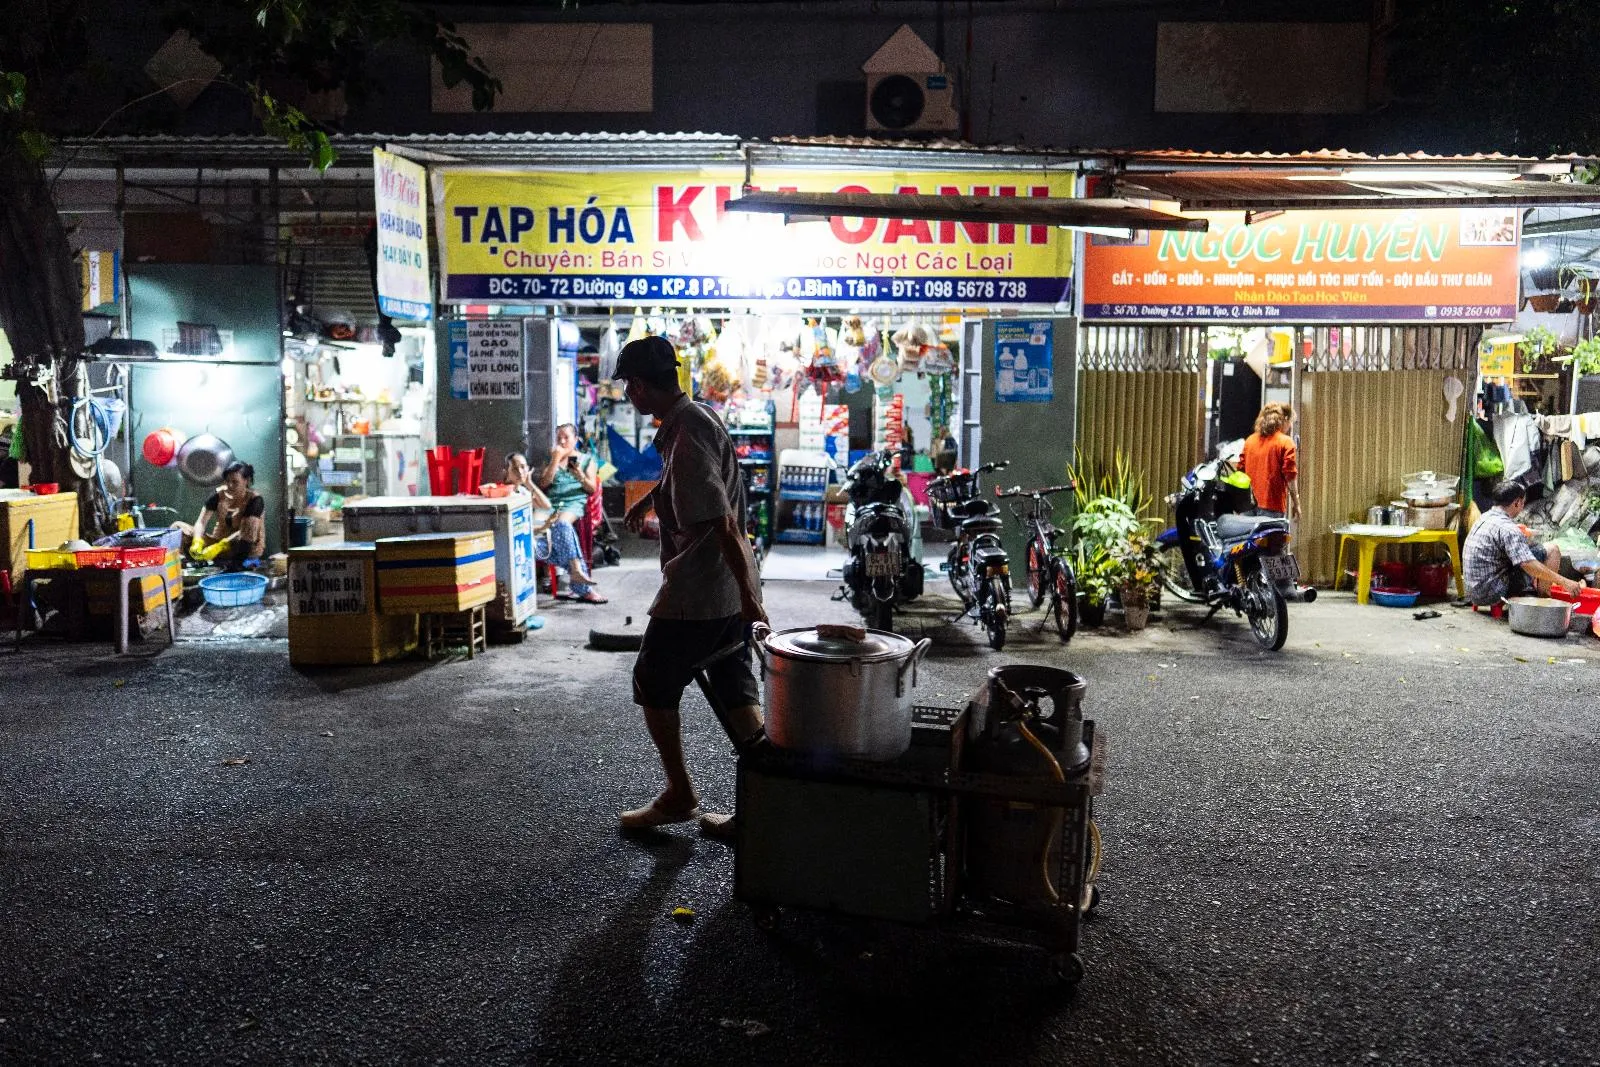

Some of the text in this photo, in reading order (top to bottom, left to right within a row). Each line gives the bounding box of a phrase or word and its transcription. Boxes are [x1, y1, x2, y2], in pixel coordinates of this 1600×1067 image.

[454, 206, 534, 254] TẠP
[549, 196, 634, 243] HÓA
[503, 250, 592, 272] Chuyên:
[602, 250, 642, 267] Bán
[857, 252, 906, 273] Ngọt
[916, 252, 957, 270] Các
[966, 252, 1013, 273] Loại
[1265, 273, 1295, 288] PHỤC
[489, 278, 518, 295] ĐC:
[550, 278, 569, 295] 72
[573, 278, 624, 299] Đường
[629, 278, 648, 296] 49
[662, 278, 699, 296] KP.8
[846, 279, 877, 297] Tân
[892, 280, 920, 297] ĐT:
[925, 280, 952, 298] 098
[957, 280, 994, 298] 5678
[999, 280, 1027, 299] 738
[1440, 306, 1463, 317] 0938
[1465, 306, 1483, 317] 260
[480, 339, 508, 349] GẠO
[470, 361, 519, 373] VUI LÒNG
